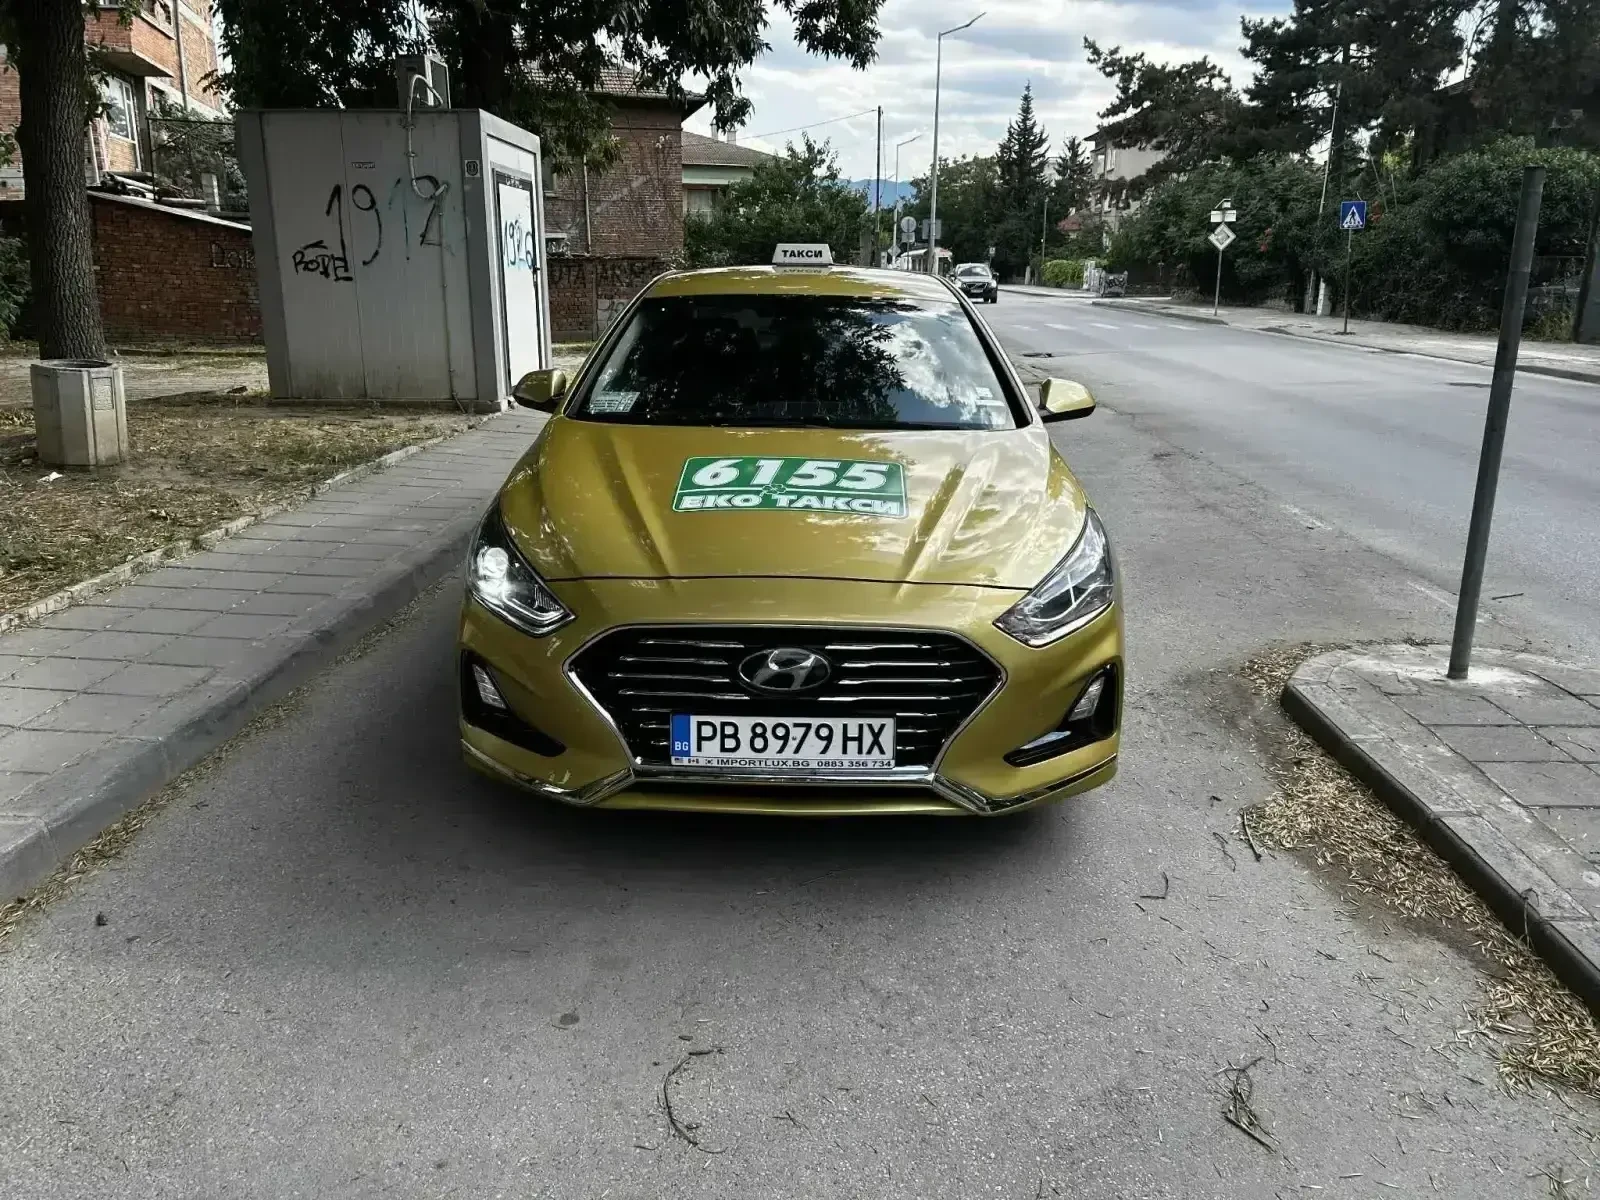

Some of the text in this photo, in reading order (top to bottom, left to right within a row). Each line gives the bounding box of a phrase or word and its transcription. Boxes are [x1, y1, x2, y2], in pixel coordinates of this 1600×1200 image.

[781, 249, 823, 258] ТАКСИ
[691, 458, 890, 490] 6155
[679, 493, 900, 515] ЕКО ТАКСИ
[674, 740, 689, 751] BG
[696, 720, 887, 755] PB 8979 HX
[716, 759, 892, 768] IMPORTLUX.BG 0883 356 734
